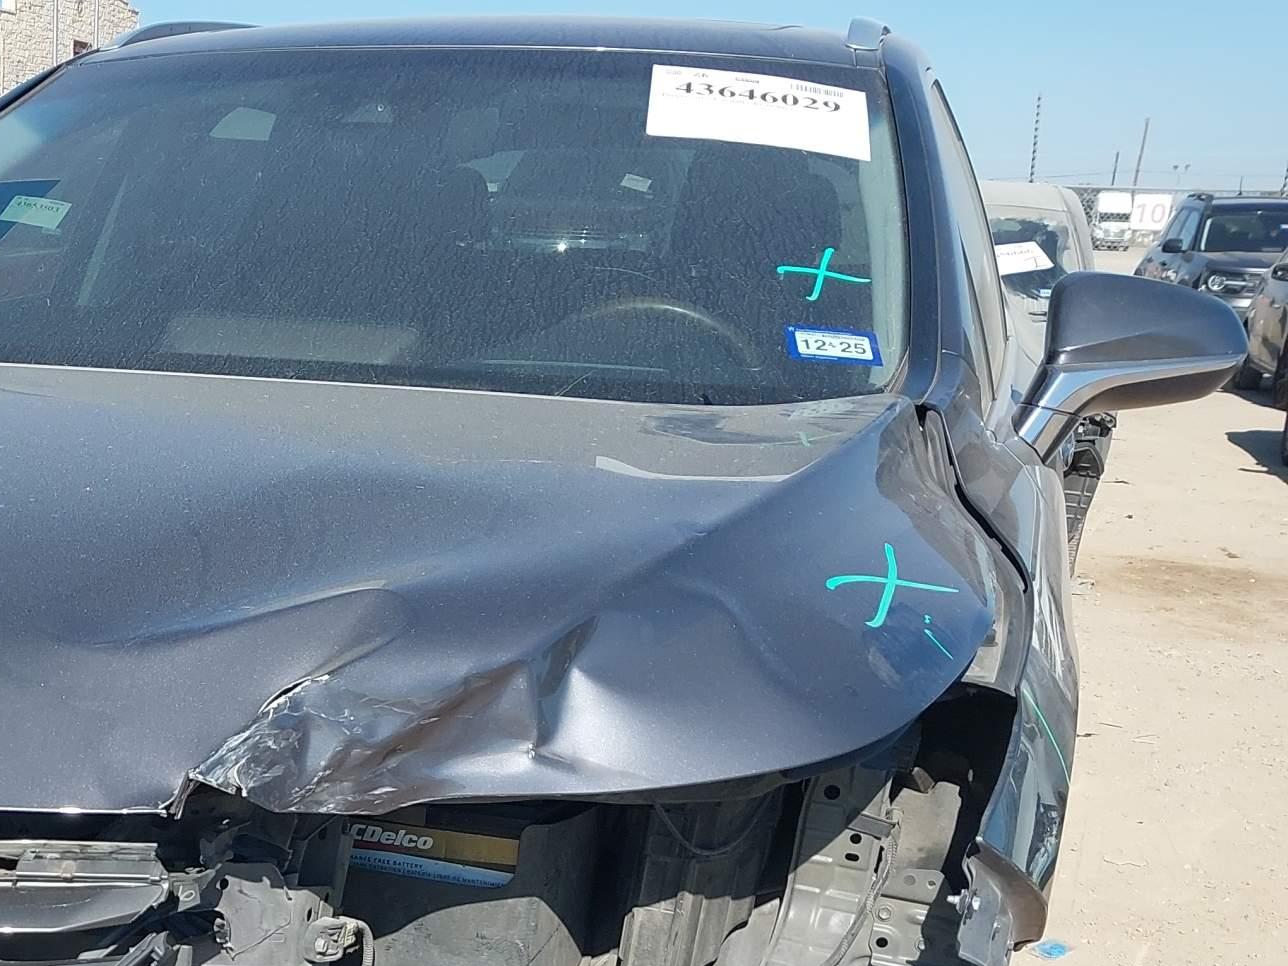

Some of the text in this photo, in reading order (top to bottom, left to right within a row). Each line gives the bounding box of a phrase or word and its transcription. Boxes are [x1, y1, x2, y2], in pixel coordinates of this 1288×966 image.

[675, 81, 841, 112] 43646029
[1136, 202, 1166, 224] 10
[800, 339, 867, 355] 12 25
[393, 859, 424, 870] BATTERY
